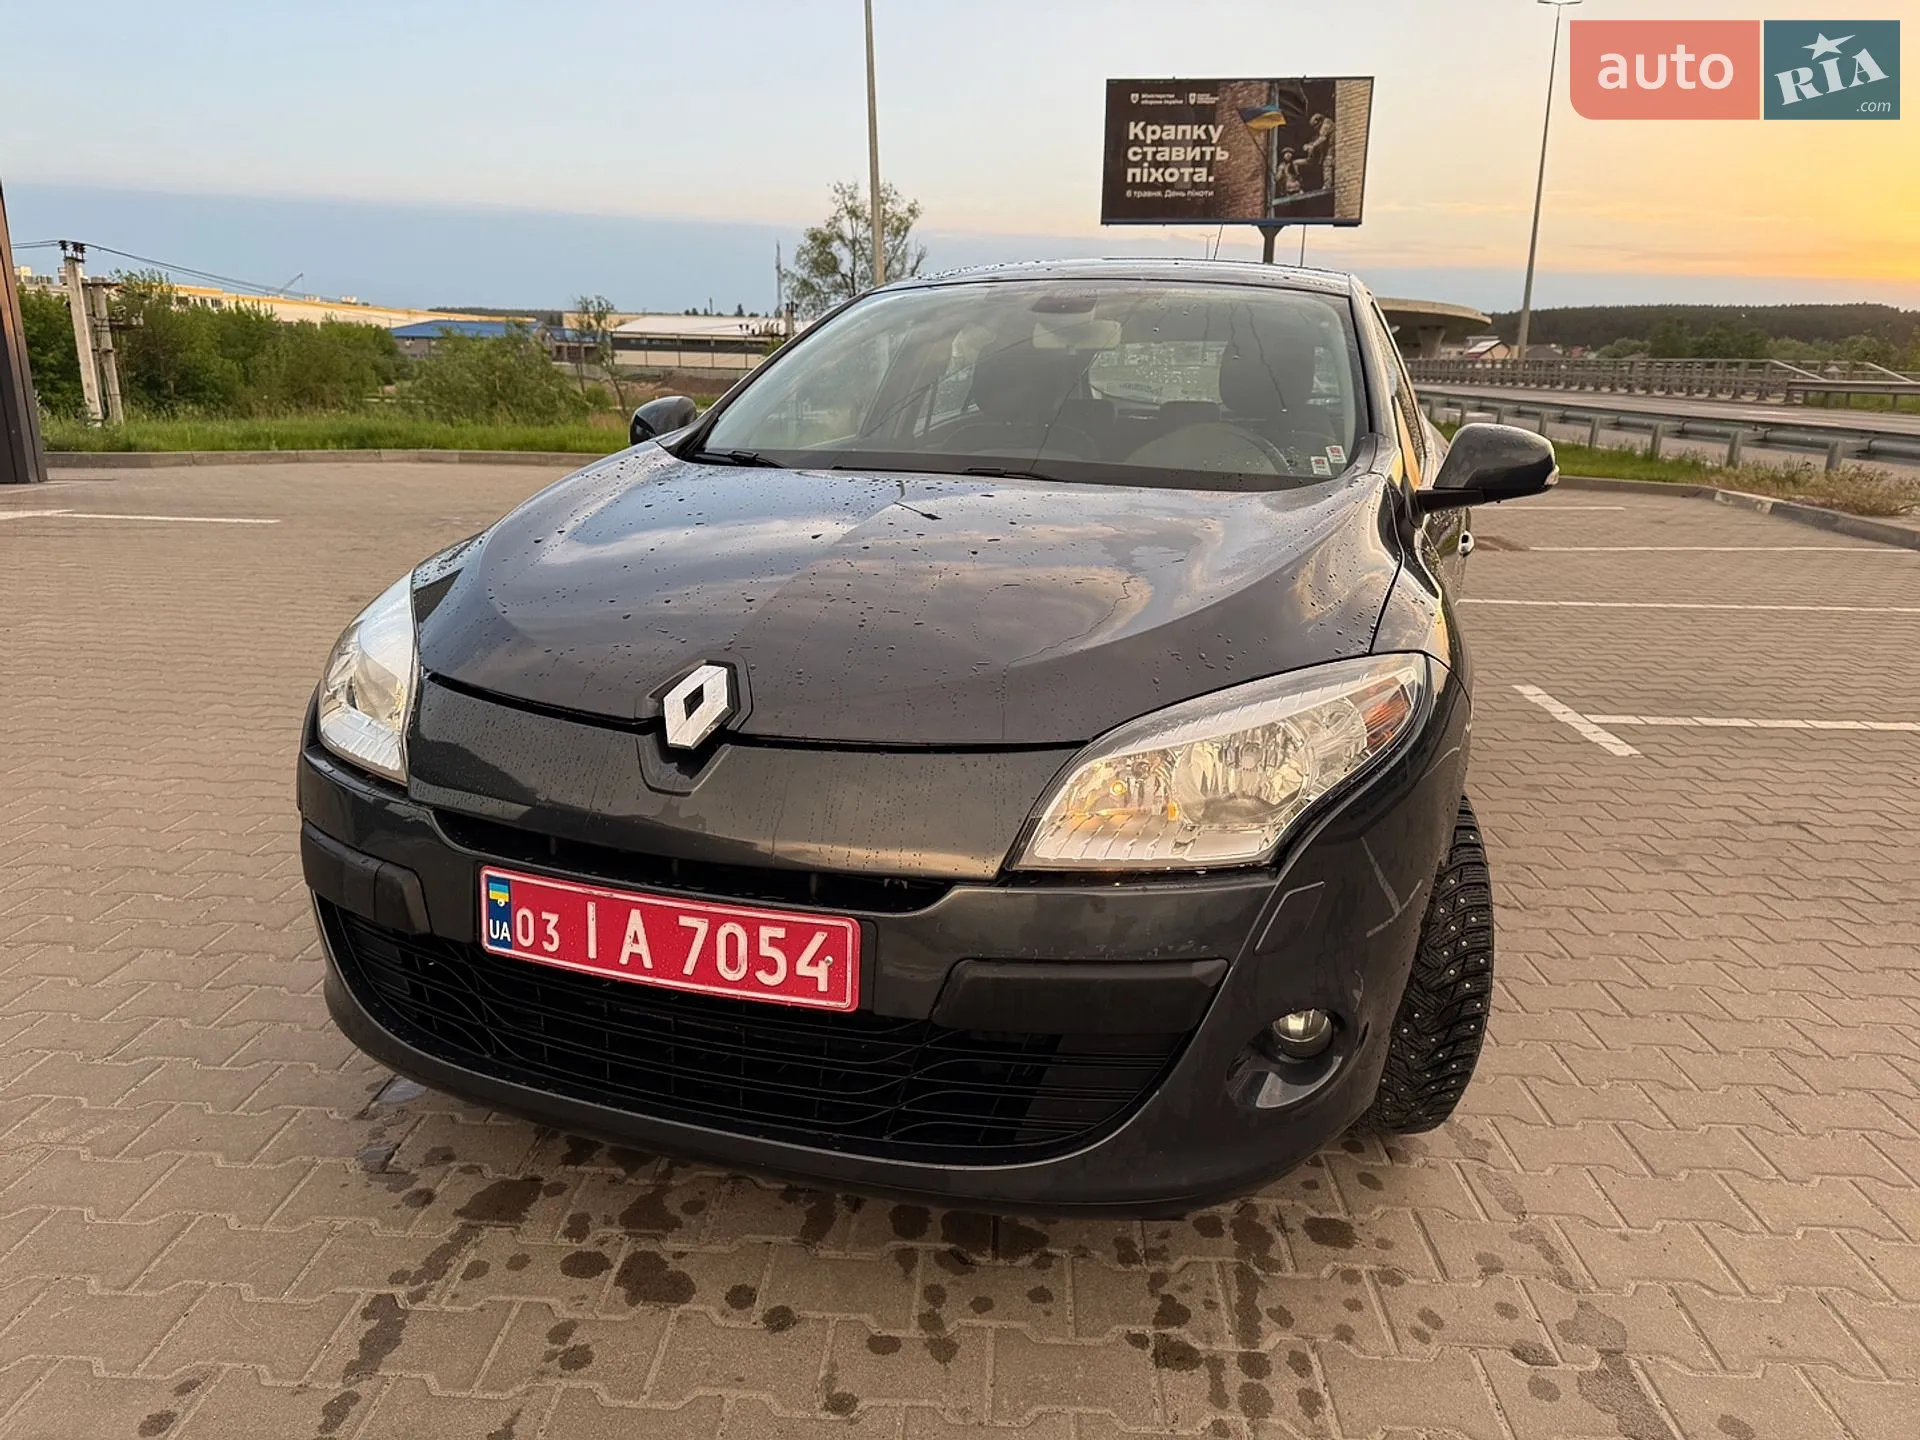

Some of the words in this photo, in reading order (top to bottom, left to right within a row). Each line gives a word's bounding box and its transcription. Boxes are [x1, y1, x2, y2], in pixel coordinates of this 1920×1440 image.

[1127, 120, 1225, 144] Крапку
[1127, 145, 1230, 162] ставить
[1126, 162, 1215, 184] піхота.
[488, 918, 512, 942] UA
[515, 907, 560, 953] 03
[586, 900, 653, 970] IA
[678, 914, 830, 993] 7054
